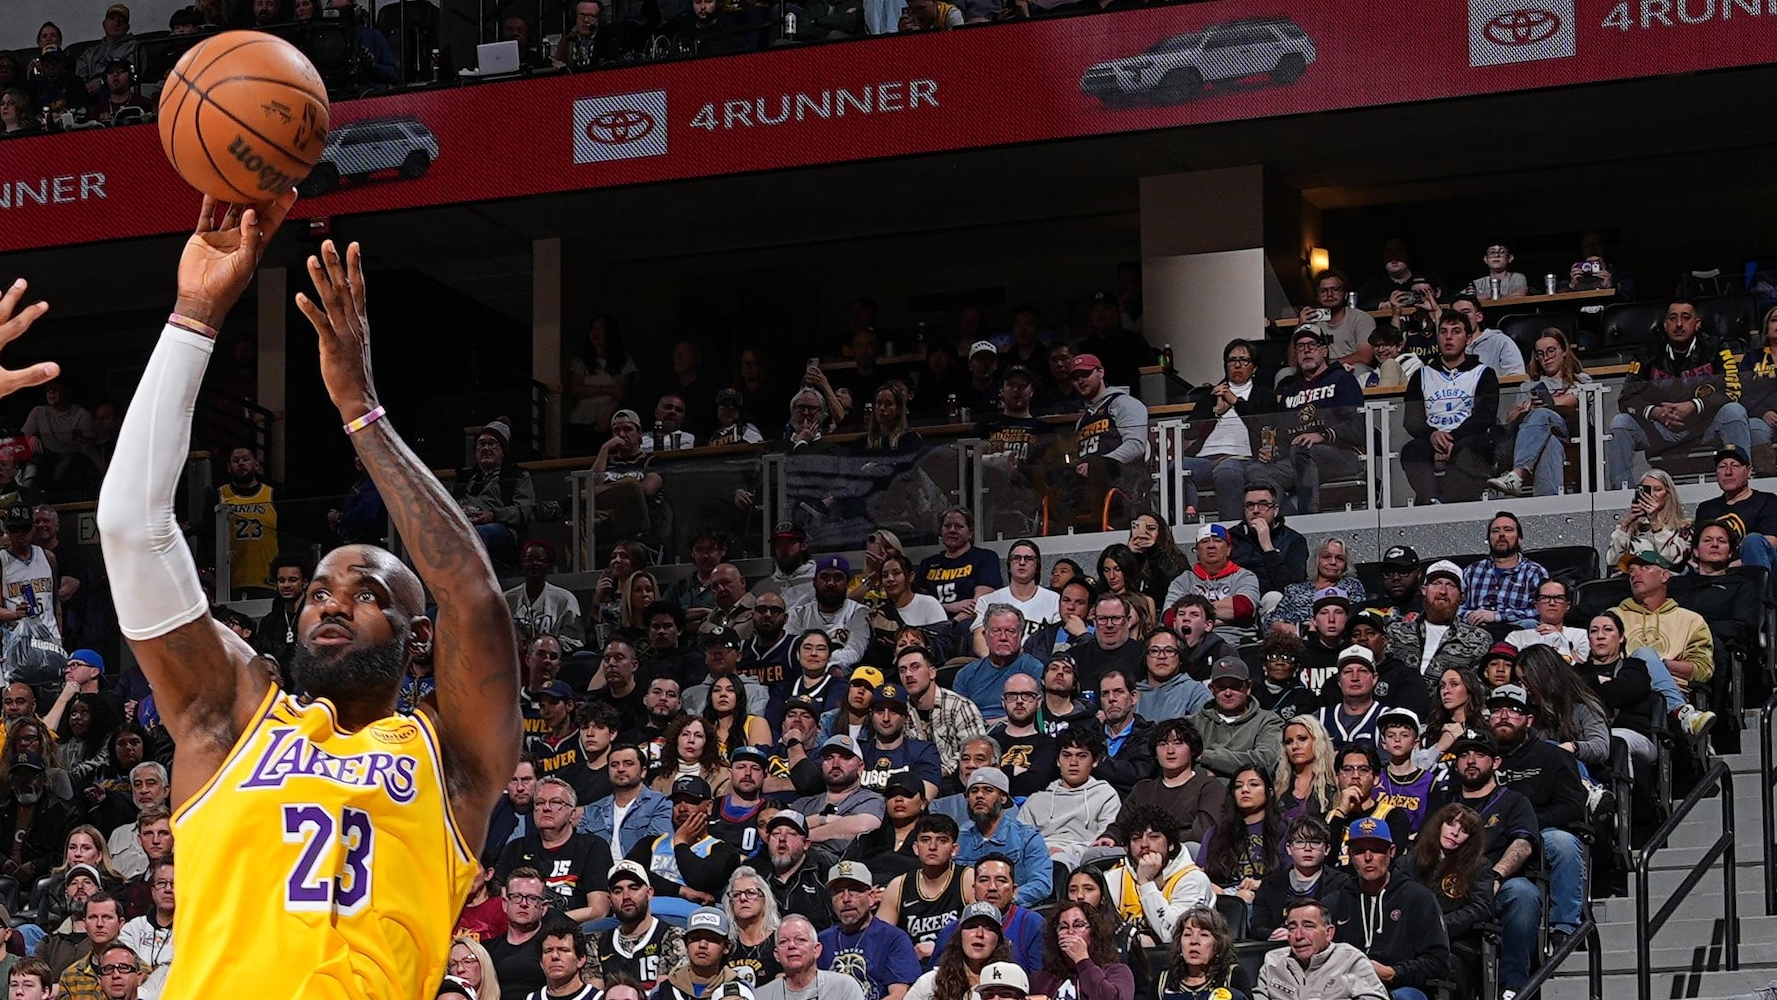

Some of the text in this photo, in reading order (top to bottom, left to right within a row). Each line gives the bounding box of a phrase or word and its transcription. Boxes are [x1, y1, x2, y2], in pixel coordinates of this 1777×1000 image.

[689, 79, 940, 132] 4RUNNER
[1078, 418, 1111, 441] ENVER
[230, 503, 266, 515] AKERS
[80, 516, 101, 541] EX
[235, 518, 263, 541] 23
[926, 563, 974, 581] DENVER
[935, 582, 958, 605] 15
[237, 727, 417, 805] LAKERS
[542, 751, 578, 770] NVER
[1373, 790, 1421, 814] LAKERS
[741, 826, 757, 852] 0
[282, 802, 376, 918] 23
[906, 911, 961, 936] LAKERS
[638, 953, 660, 982] 15
